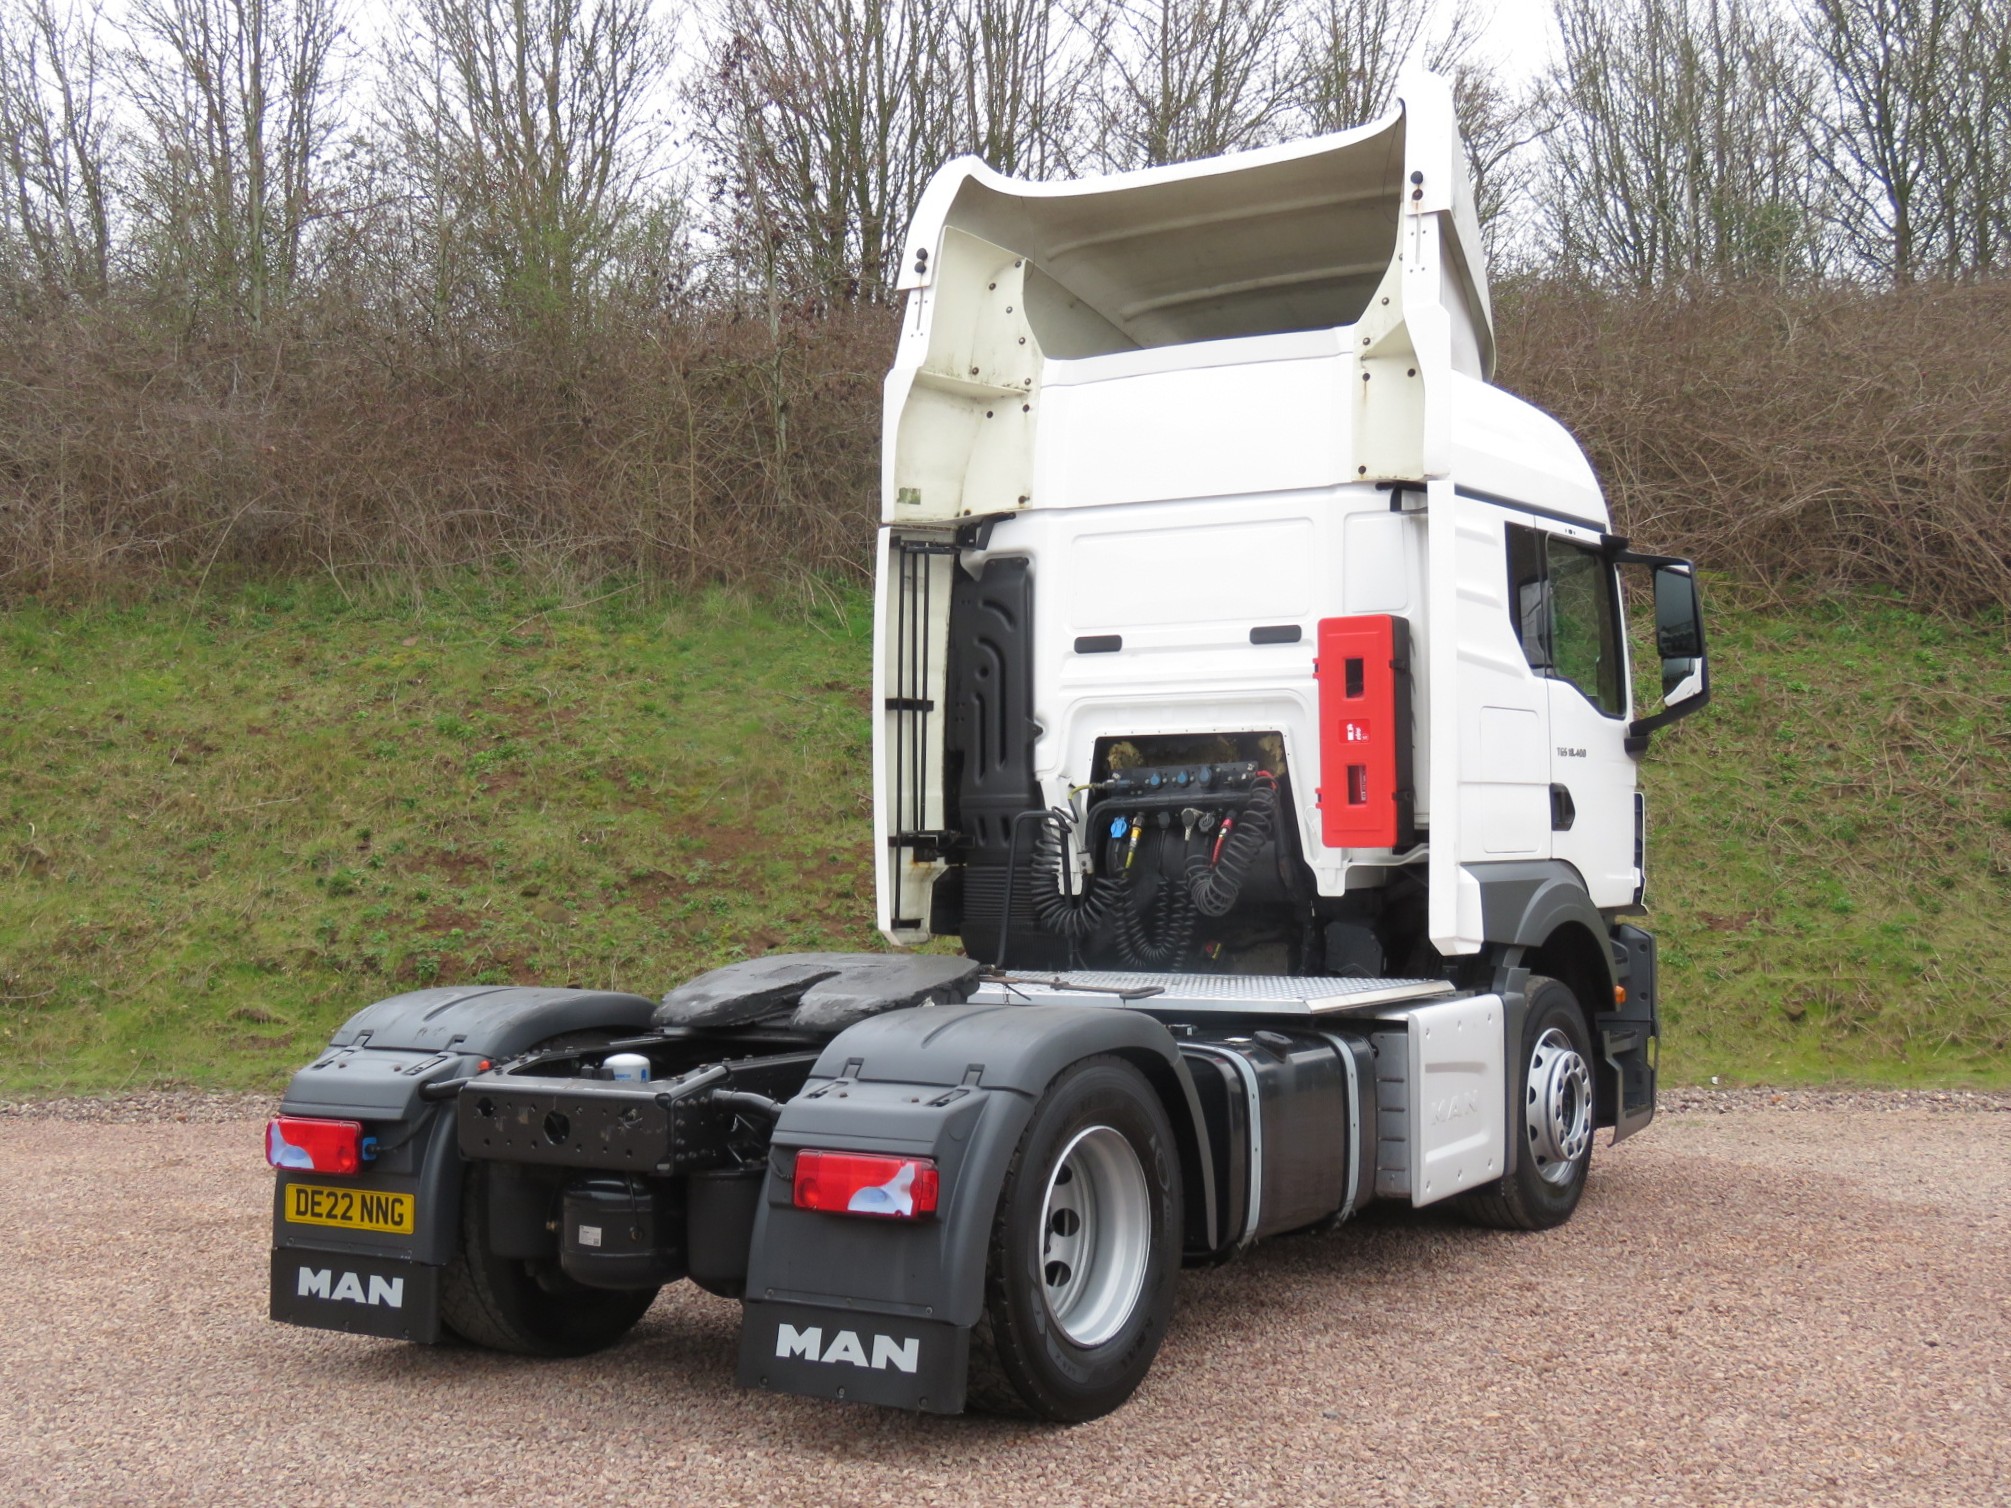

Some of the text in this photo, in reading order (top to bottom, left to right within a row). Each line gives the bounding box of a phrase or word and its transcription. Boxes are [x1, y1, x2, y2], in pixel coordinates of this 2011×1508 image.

[295, 1188, 404, 1227] DE22 NNG
[298, 1266, 404, 1308] MAN
[775, 1323, 920, 1374] MAN
